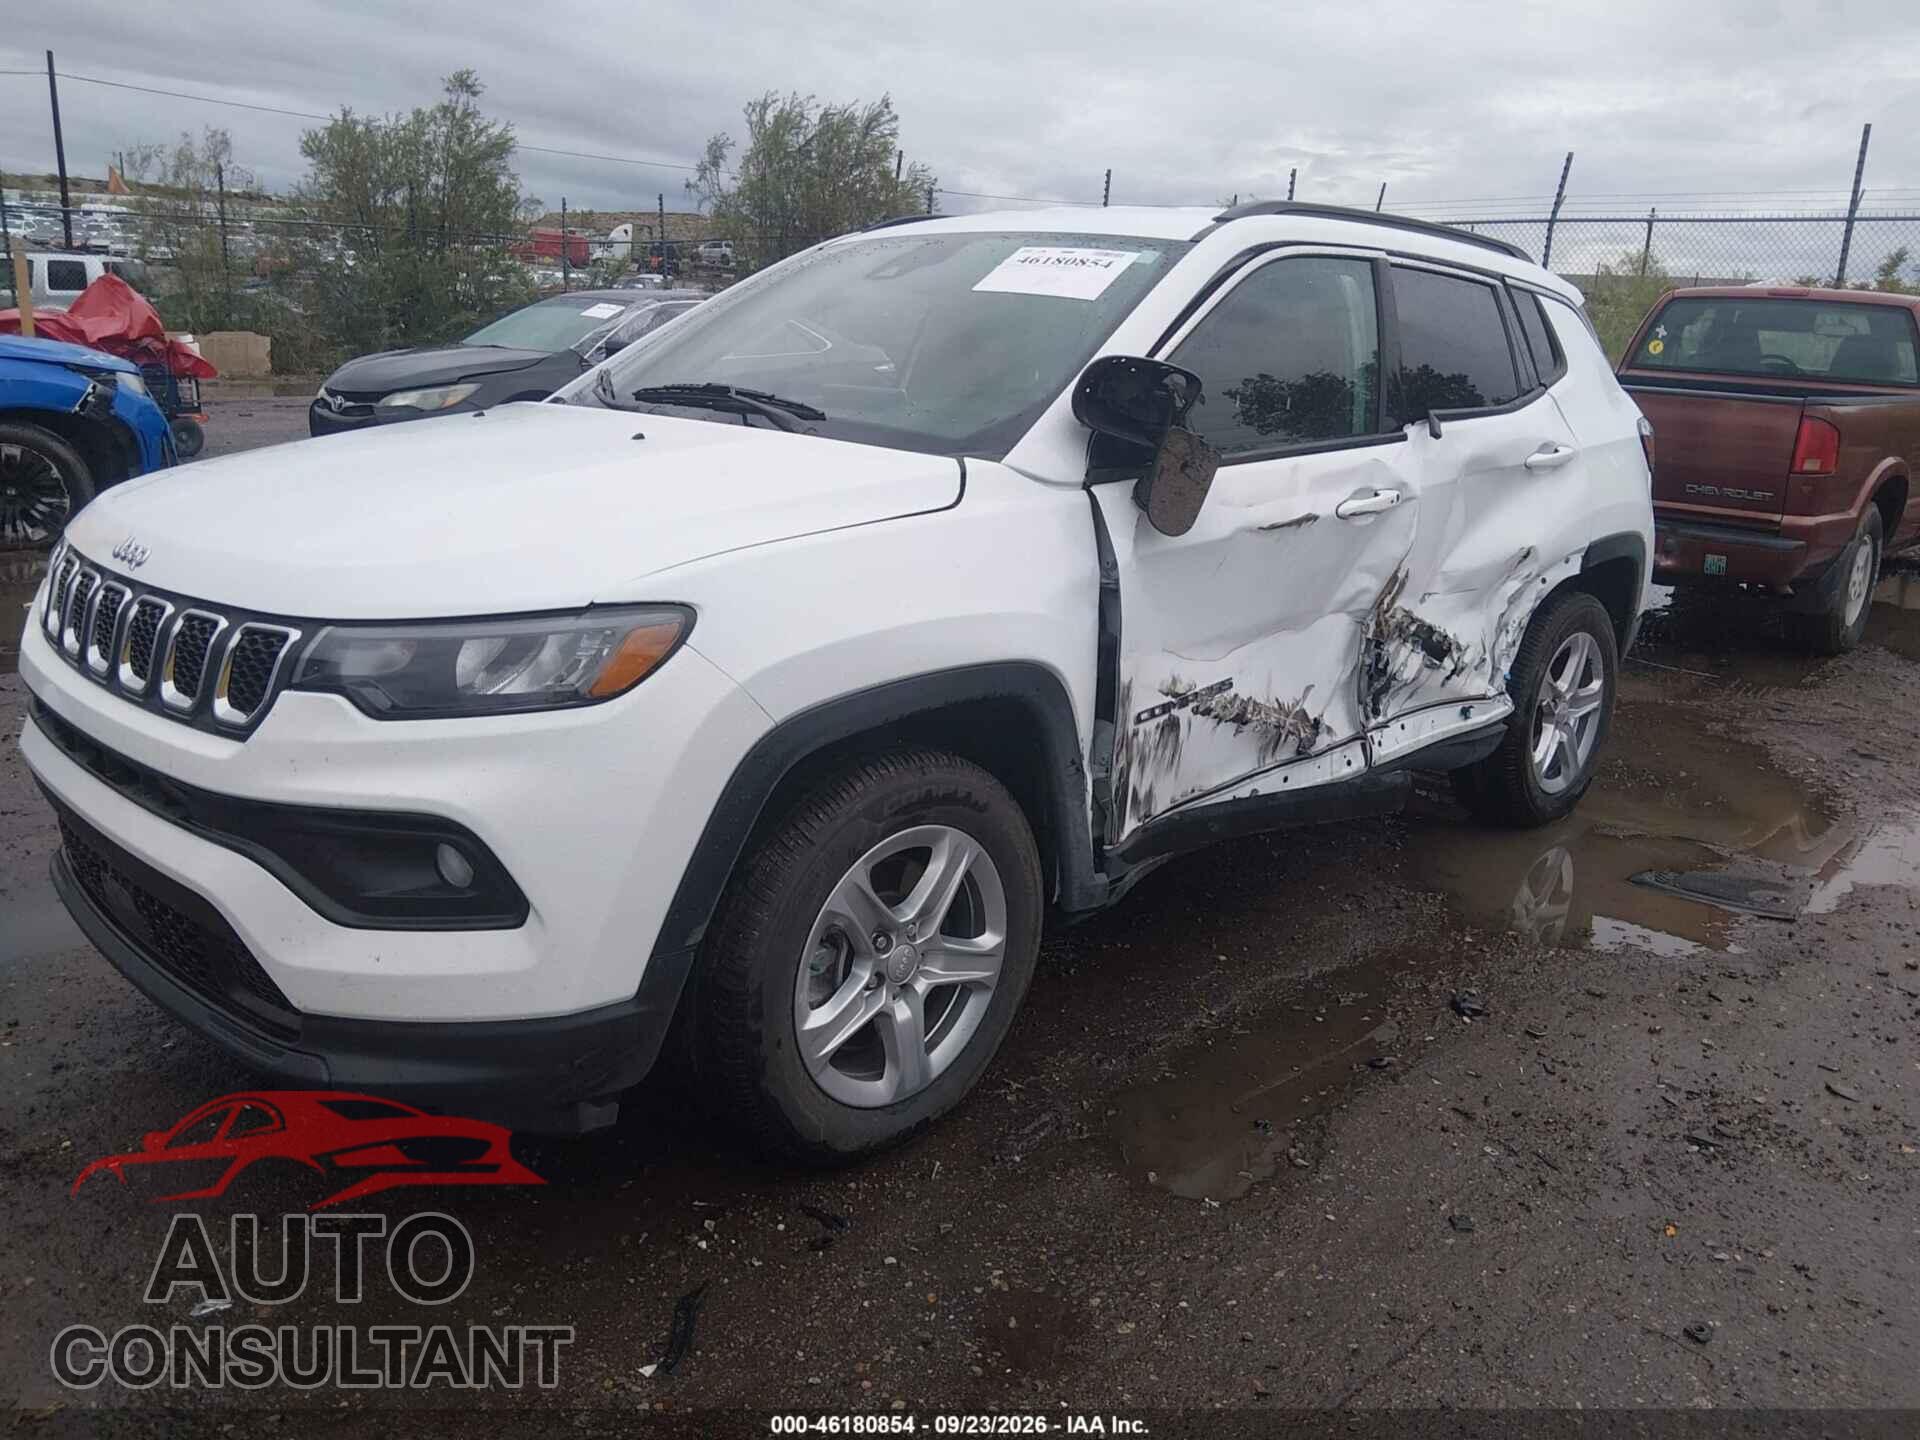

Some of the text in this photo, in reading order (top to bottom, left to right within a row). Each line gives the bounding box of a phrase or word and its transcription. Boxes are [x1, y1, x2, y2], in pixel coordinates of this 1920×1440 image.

[1016, 256, 1114, 269] 46180854
[1685, 483, 1775, 502] CHEVROLET
[112, 537, 152, 571] Jeep
